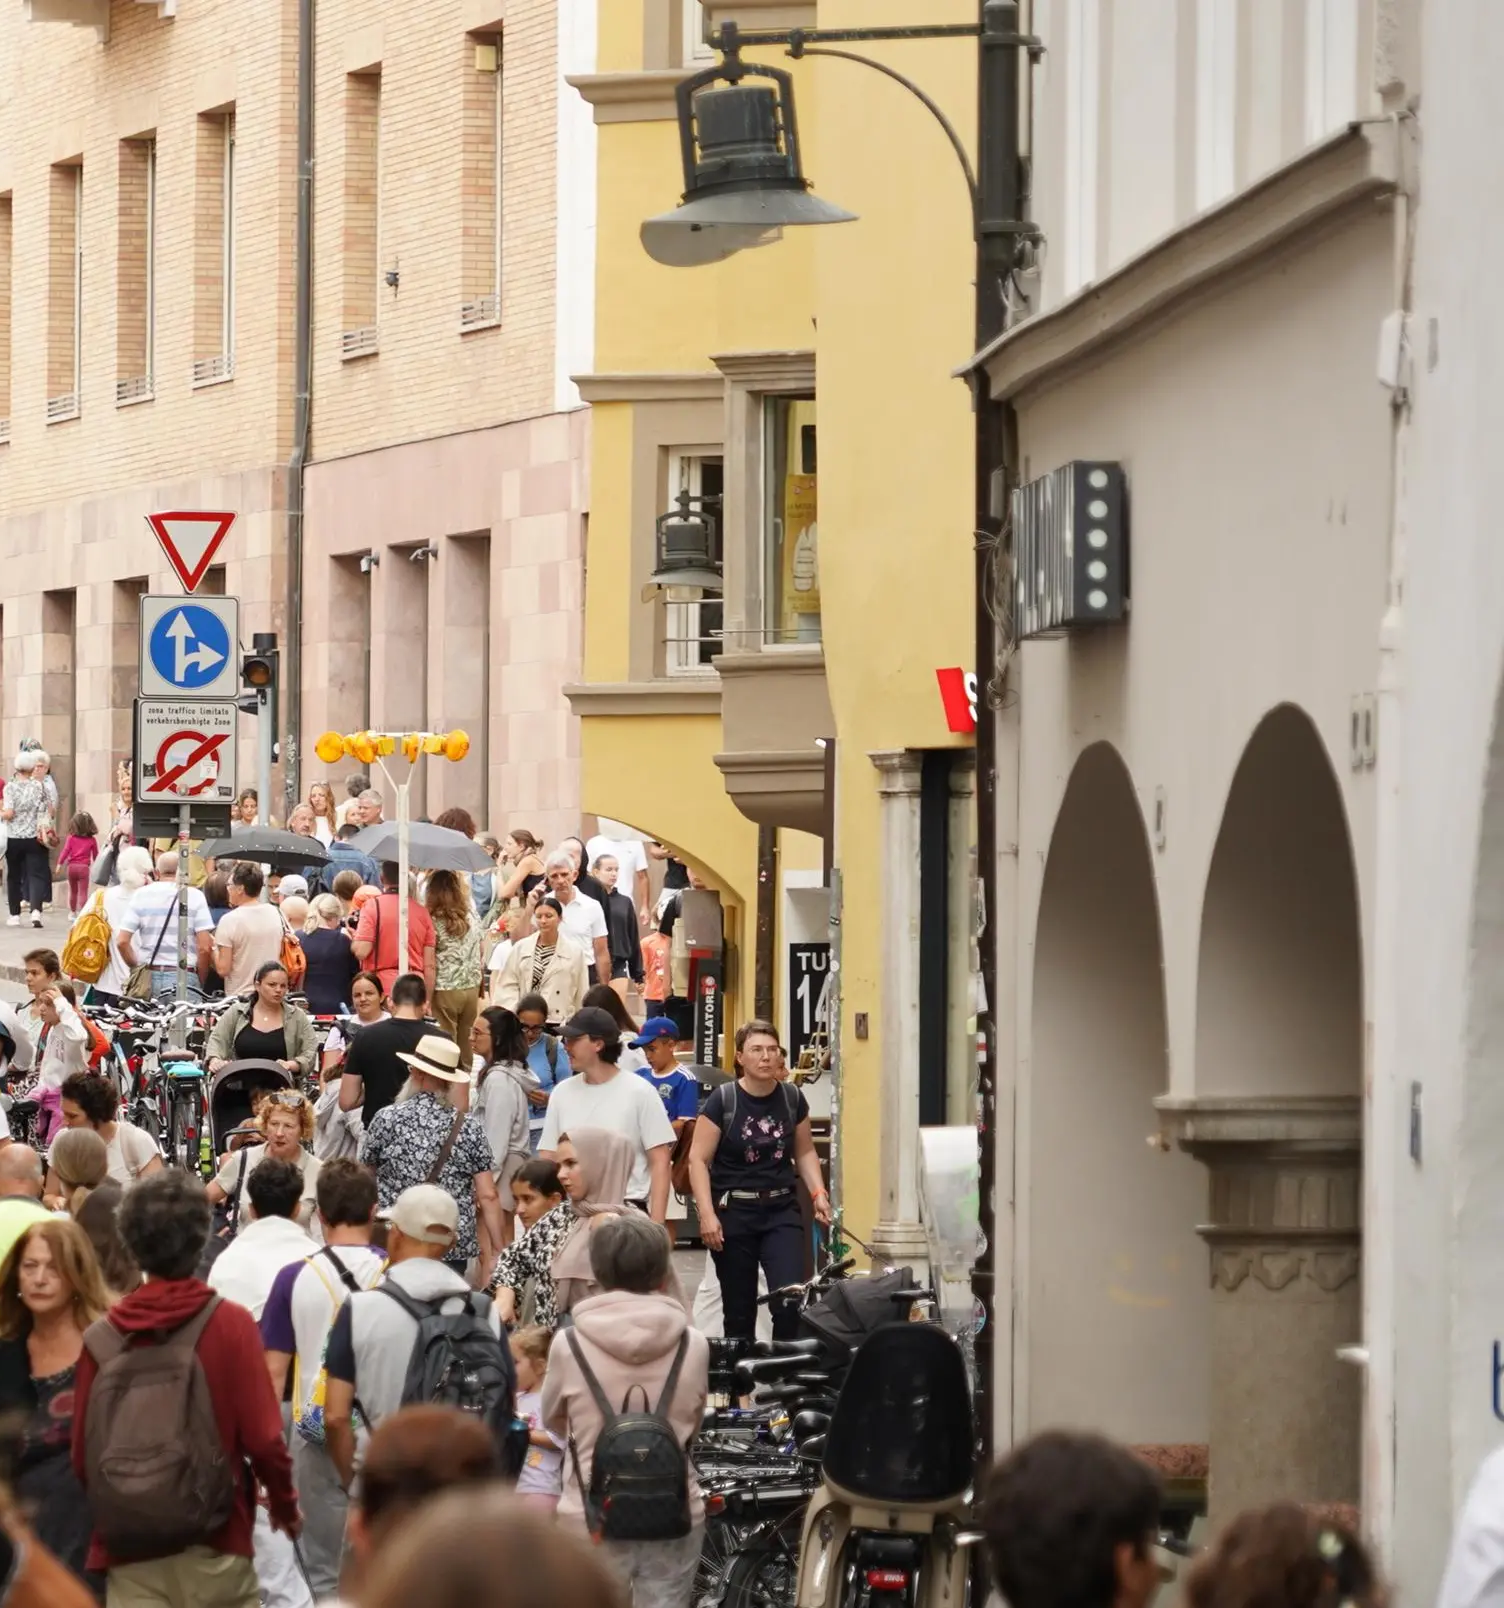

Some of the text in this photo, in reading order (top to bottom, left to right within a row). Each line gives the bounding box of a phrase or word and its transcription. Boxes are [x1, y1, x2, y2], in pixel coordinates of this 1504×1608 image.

[168, 706, 196, 715] traffico
[200, 707, 229, 715] limitato
[146, 717, 231, 726] verkehrsberuhigte Zone
[797, 952, 831, 971] TU
